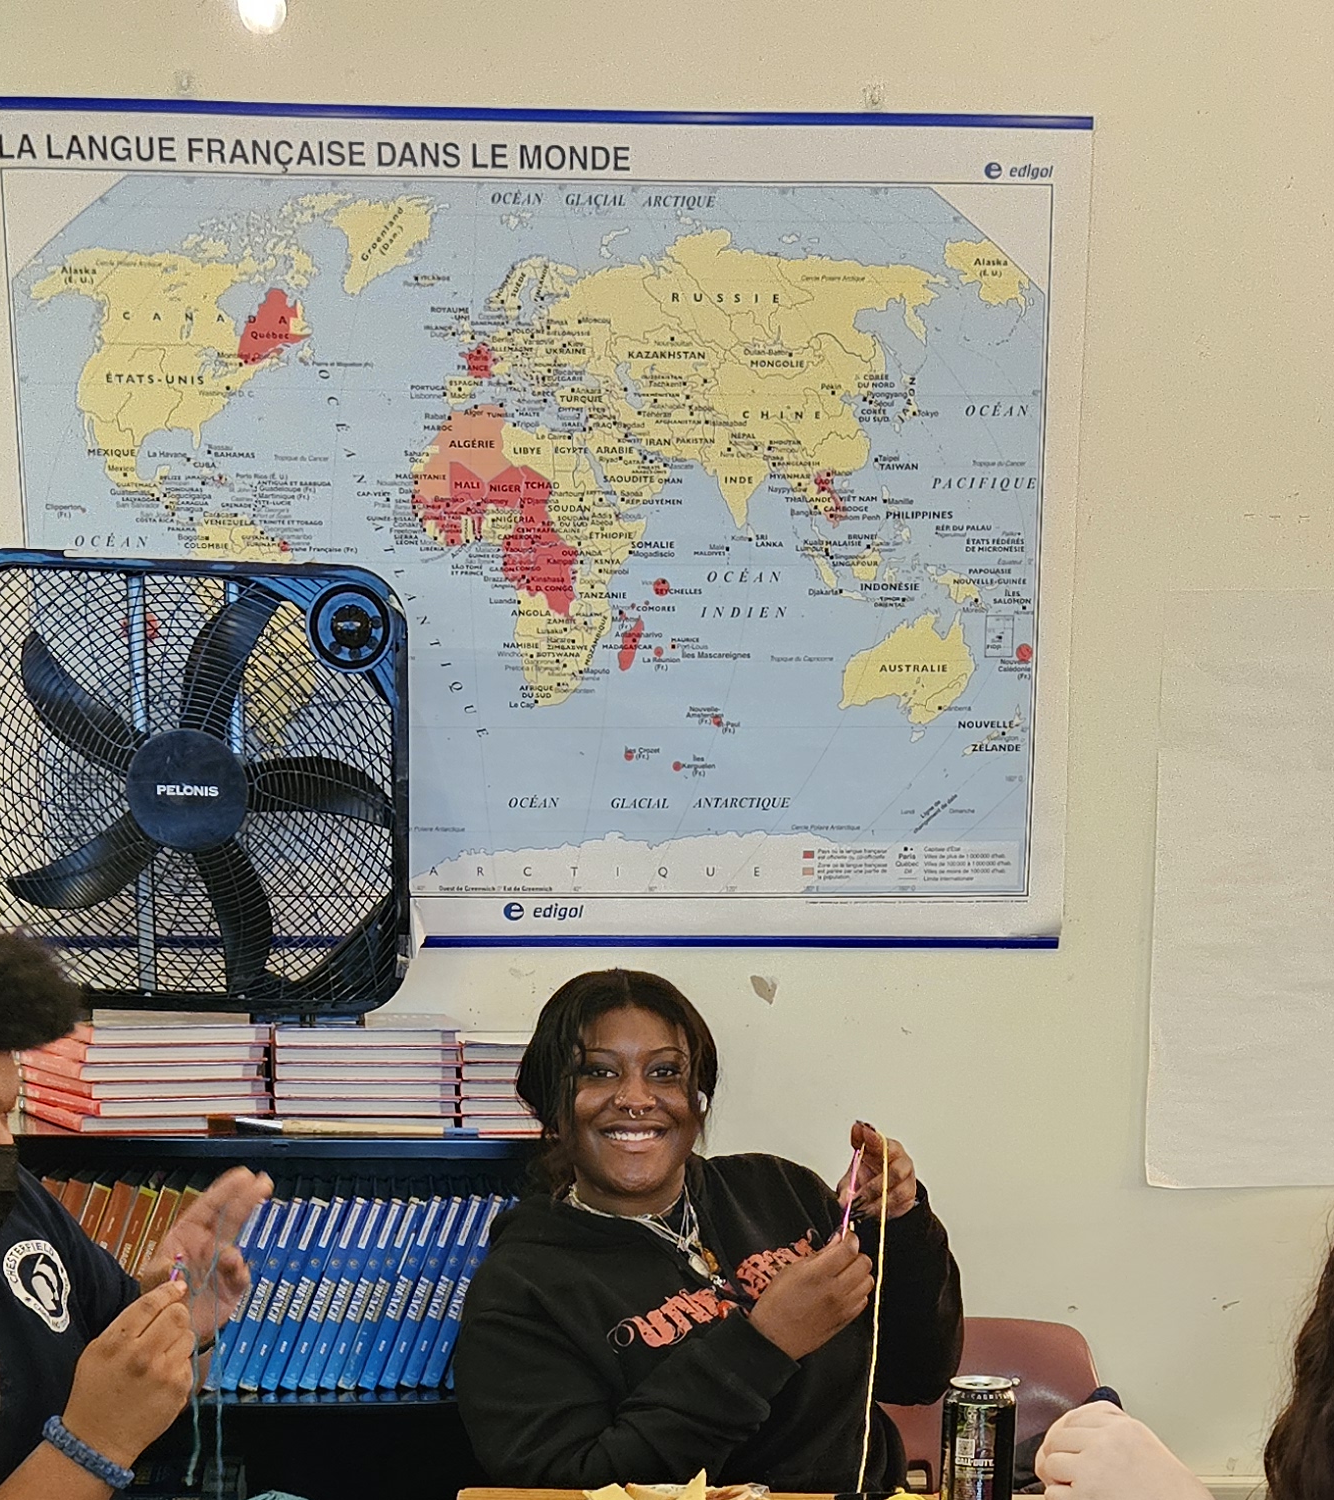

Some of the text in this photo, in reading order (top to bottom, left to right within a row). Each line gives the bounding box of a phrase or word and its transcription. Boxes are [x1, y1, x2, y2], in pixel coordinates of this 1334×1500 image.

[46, 134, 176, 162] LANGUE
[188, 138, 366, 173] FRANÇAISE
[377, 142, 460, 167] DANS
[472, 143, 508, 169] LE
[519, 144, 631, 172] MONDE
[491, 192, 716, 210] OCÉAN GLACIAL ARCTIQUE
[973, 258, 1008, 267] Alaska
[61, 266, 97, 276] Alaska
[672, 293, 780, 304] RUSSIE
[123, 311, 287, 325] CANADA
[250, 330, 290, 340] Québec
[628, 351, 706, 360] KAZAKHSTAN
[750, 359, 805, 368] MONGOLIE
[106, 373, 205, 385] ÉTATS-UNIS
[871, 381, 896, 389] NORD
[560, 395, 603, 404] TURQUIE
[464, 408, 484, 417] Alger
[965, 402, 1030, 417] OCÉAN
[424, 413, 447, 421] Rabat
[743, 410, 821, 420] CHINE
[731, 432, 756, 440] NÉPAL
[449, 438, 496, 449] ALGÉRIE
[645, 438, 671, 446] IRAN
[676, 437, 716, 445] PAKISTAN
[404, 450, 430, 458] Sahara
[513, 446, 542, 455] LIBYE
[554, 445, 588, 454] ÉGYPTE
[597, 446, 634, 455] ARABIE
[214, 451, 256, 460] BAHAMAS
[879, 463, 919, 471] TAIWAN
[603, 475, 655, 484] SAOUDITE
[657, 477, 683, 485] OMAN
[724, 476, 754, 485] INDE
[932, 477, 1038, 491] PACIFIQUE
[454, 481, 480, 490] MALI
[489, 484, 521, 494] NIGER
[525, 481, 560, 490] TCHAD
[547, 504, 591, 513] SOUDAN
[885, 511, 954, 520] PHILIPPINES
[74, 532, 149, 548] OCÉAN
[966, 537, 1025, 545] ÉTATS FÉDÉRÉS
[184, 542, 229, 550] COLOMBIE
[631, 541, 675, 549] SOMALIE
[965, 545, 977, 553] DE
[633, 550, 675, 559] Mogadiscio
[707, 568, 782, 583] OCÉAN
[860, 582, 920, 591] INDONÉSIE
[578, 591, 627, 599] TANZANIE
[993, 597, 1032, 605] SALOMON
[510, 609, 552, 617] ANGOLA
[636, 605, 676, 613] COMORES
[700, 606, 788, 619] INDIEN
[697, 651, 751, 660] Mascareignes
[879, 664, 948, 673] AUSTRALIE
[509, 701, 535, 709] Le Cap
[156, 784, 219, 797] PELONIS
[508, 794, 792, 811] OCÉAN GLACIAL ANTARCTIQUE
[533, 903, 584, 921] edigol
[5, 1241, 55, 1284] CHESTERFIELD
[246, 1276, 269, 1321] FRENCH
[267, 1279, 291, 1323] FRENCH
[287, 1276, 311, 1321] FRENCH
[308, 1276, 332, 1322] FRENCH
[326, 1277, 350, 1322] FRENCH
[345, 1276, 369, 1321] FRENCH
[365, 1277, 387, 1321] FRENCH
[386, 1275, 409, 1320] FRENCH
[407, 1276, 430, 1321] FRENCH
[427, 1275, 450, 1320] FRENCH
[447, 1276, 471, 1320] FRENCH
